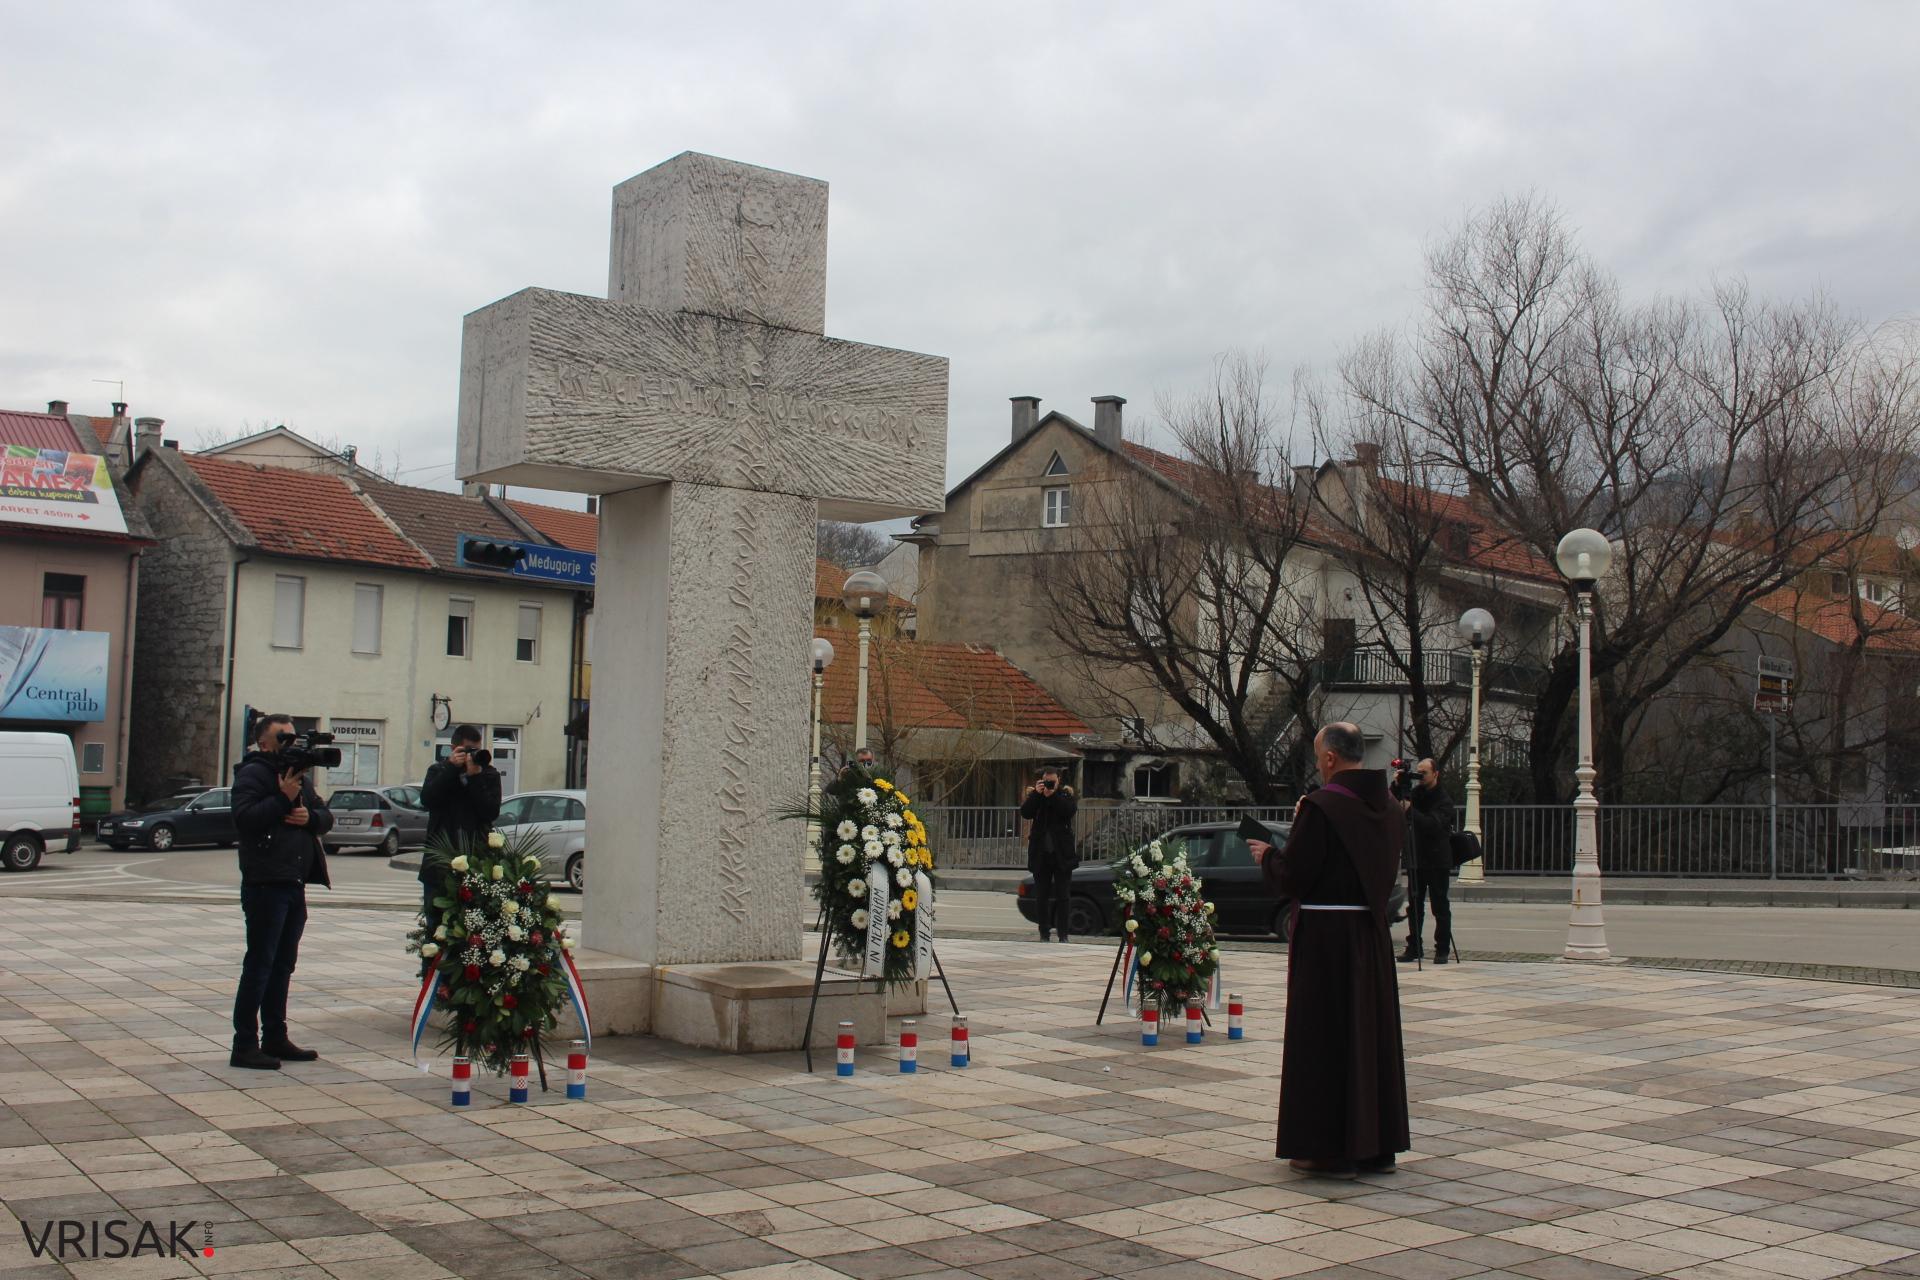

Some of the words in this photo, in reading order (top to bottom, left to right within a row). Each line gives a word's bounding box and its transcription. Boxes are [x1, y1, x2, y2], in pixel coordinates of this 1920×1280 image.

[26, 686, 87, 702] Central
[66, 698, 98, 714] pub
[332, 726, 377, 736] VIDEOTEKA
[869, 950, 881, 964] IN
